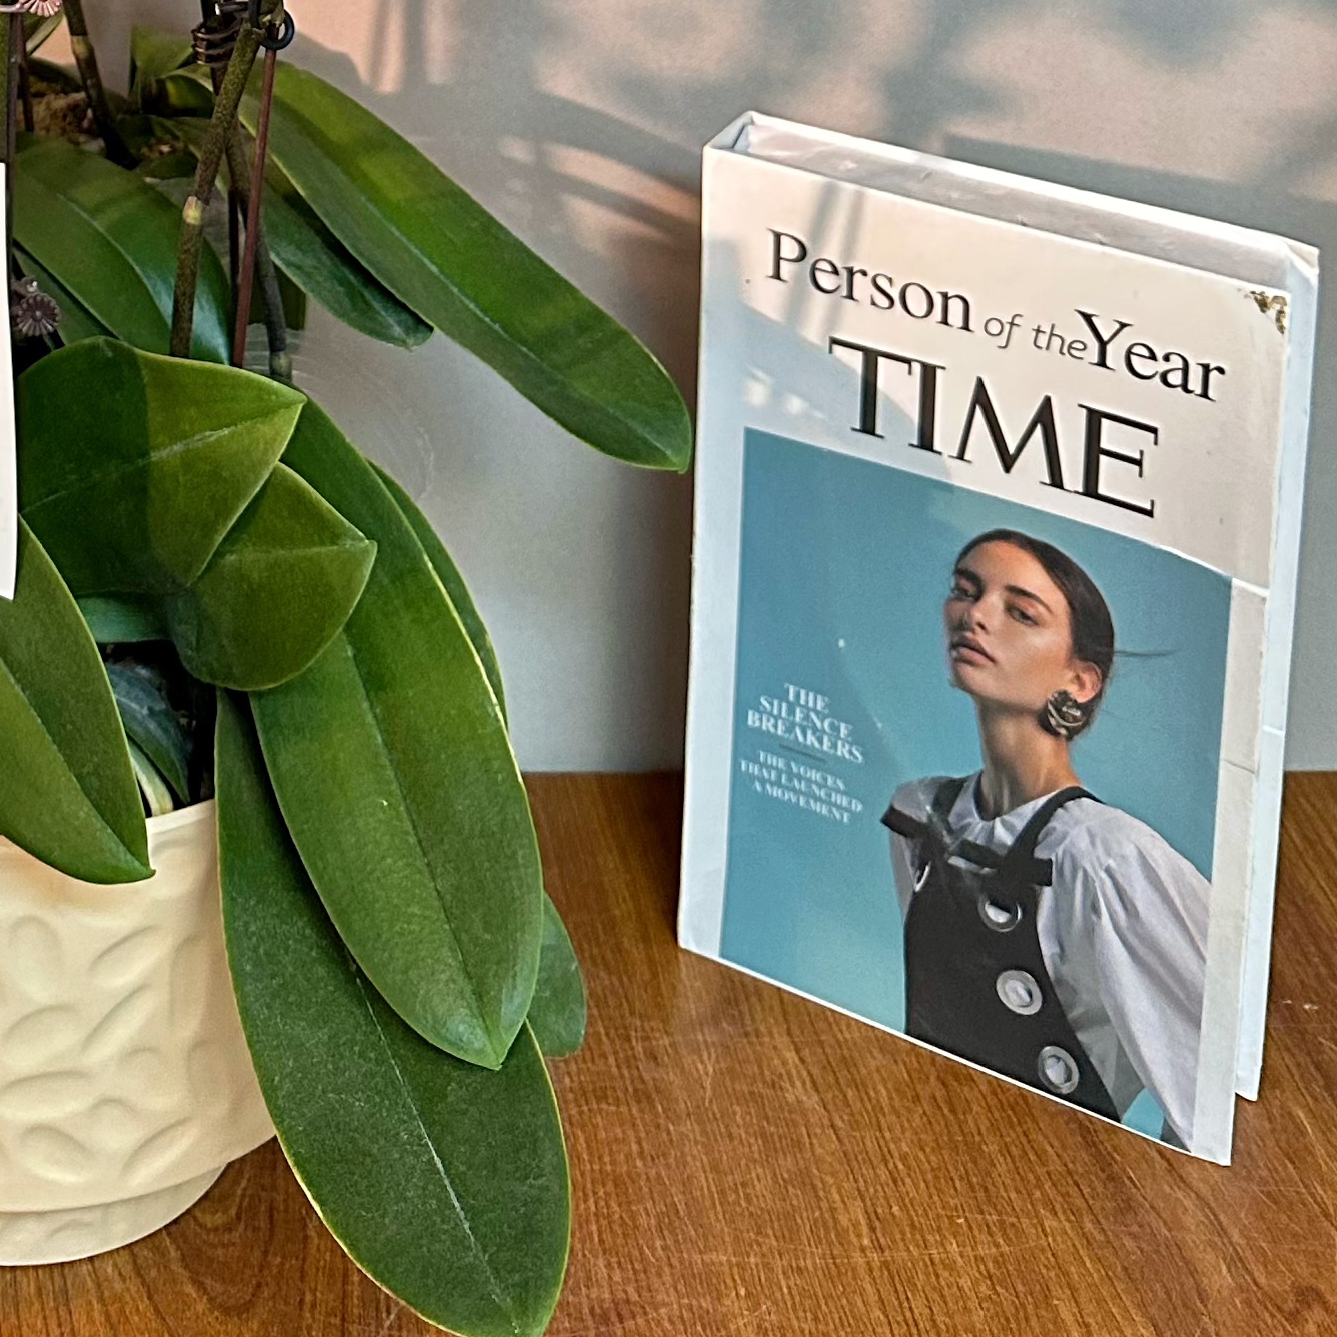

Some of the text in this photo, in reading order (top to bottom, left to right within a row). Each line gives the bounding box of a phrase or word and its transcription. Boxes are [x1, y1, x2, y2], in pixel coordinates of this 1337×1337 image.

[766, 228, 1227, 403] Person of the Year
[828, 335, 1160, 519] TIME
[759, 695, 854, 742] SILENCE
[784, 682, 830, 713] THE
[747, 709, 864, 763] BREAKERS
[758, 749, 787, 770] THE
[764, 782, 852, 824] MOVEMENT
